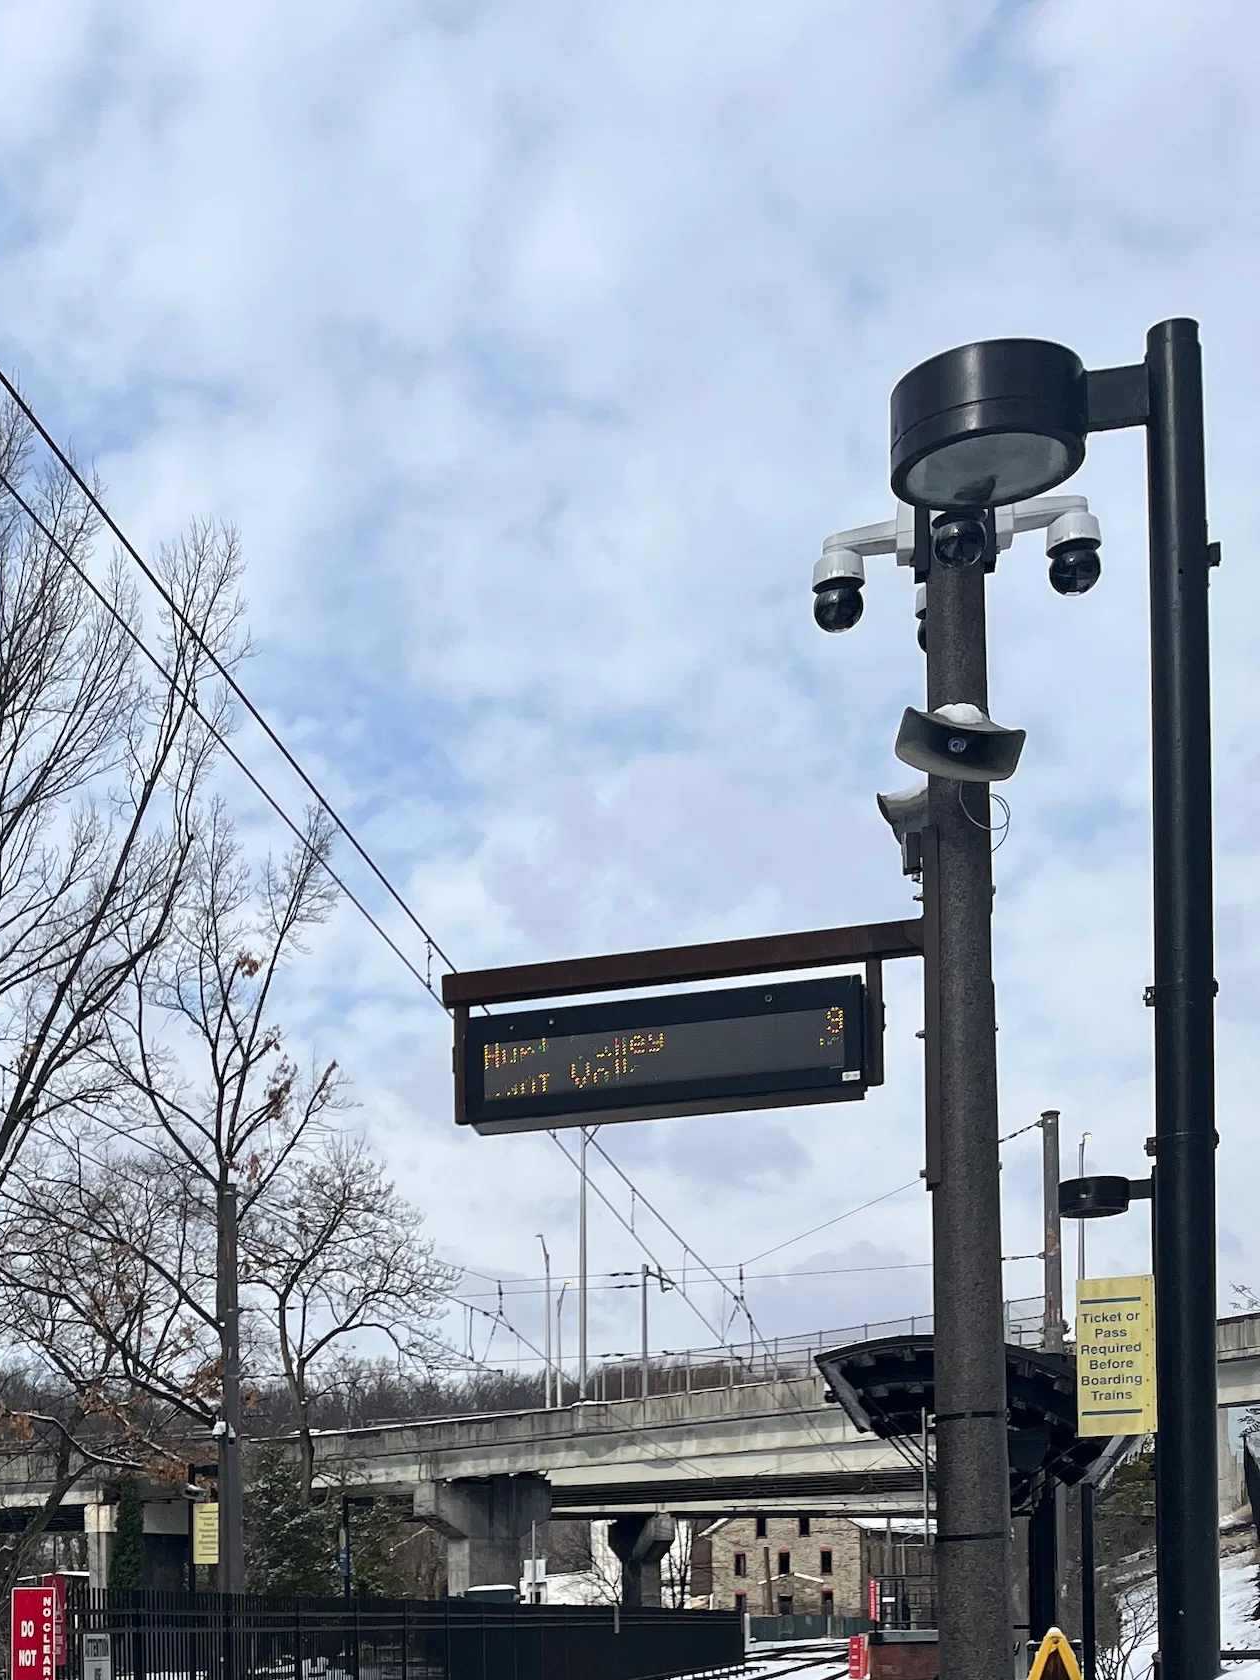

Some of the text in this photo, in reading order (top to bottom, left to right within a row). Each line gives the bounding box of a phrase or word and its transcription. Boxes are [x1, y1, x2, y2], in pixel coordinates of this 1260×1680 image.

[826, 1006, 844, 1034] 9
[1081, 1311, 1140, 1324] Ticket or
[1095, 1328, 1127, 1338] Pass
[1081, 1342, 1142, 1356] Required
[1089, 1359, 1134, 1370] Before
[1081, 1374, 1142, 1386] Boarding
[1091, 1389, 1133, 1401] Trains
[43, 1597, 51, 1618] NO
[21, 1620, 34, 1638] DO
[18, 1649, 37, 1666] NOT
